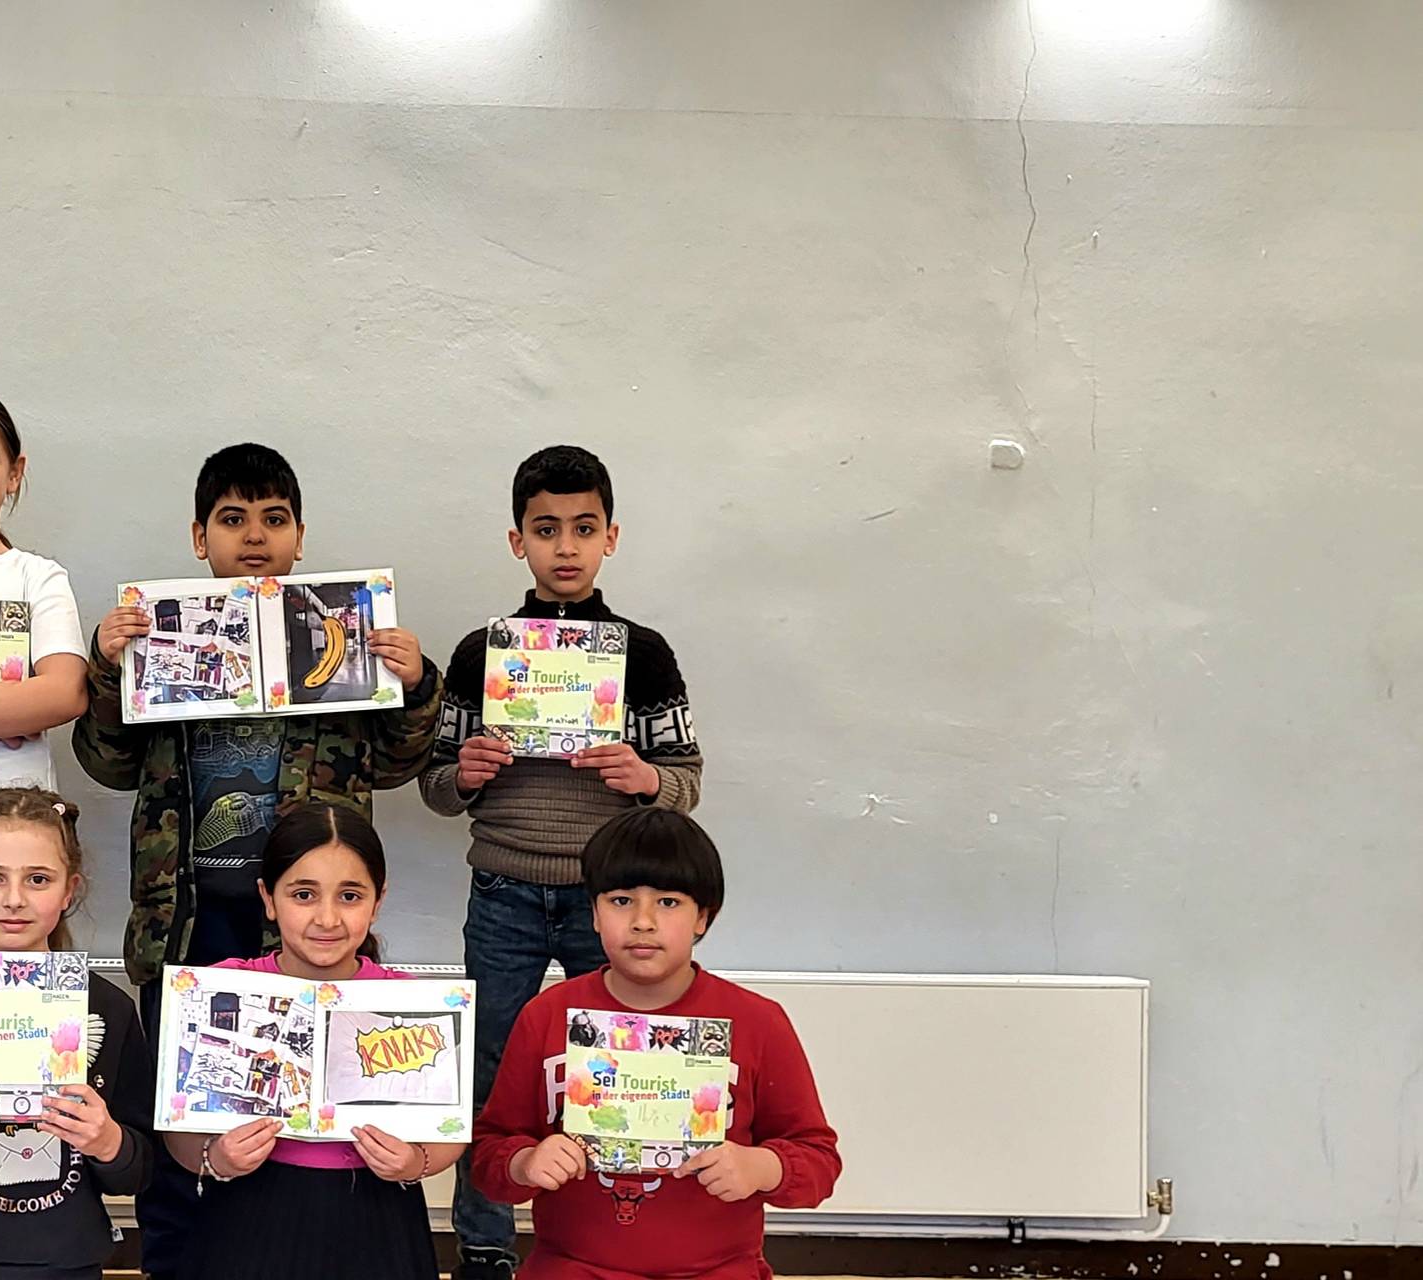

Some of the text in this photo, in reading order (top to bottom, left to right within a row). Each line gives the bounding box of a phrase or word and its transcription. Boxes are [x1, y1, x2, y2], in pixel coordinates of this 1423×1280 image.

[508, 669, 581, 684] Sei Tourist
[507, 685, 516, 694] in
[517, 685, 530, 694] der
[532, 684, 564, 695] eigenen
[17, 1027, 48, 1040] Stadt!
[592, 1071, 678, 1092] Sei Tourist
[592, 1089, 690, 1102] in der eigenen Stadt!
[62, 1170, 81, 1194] TO
